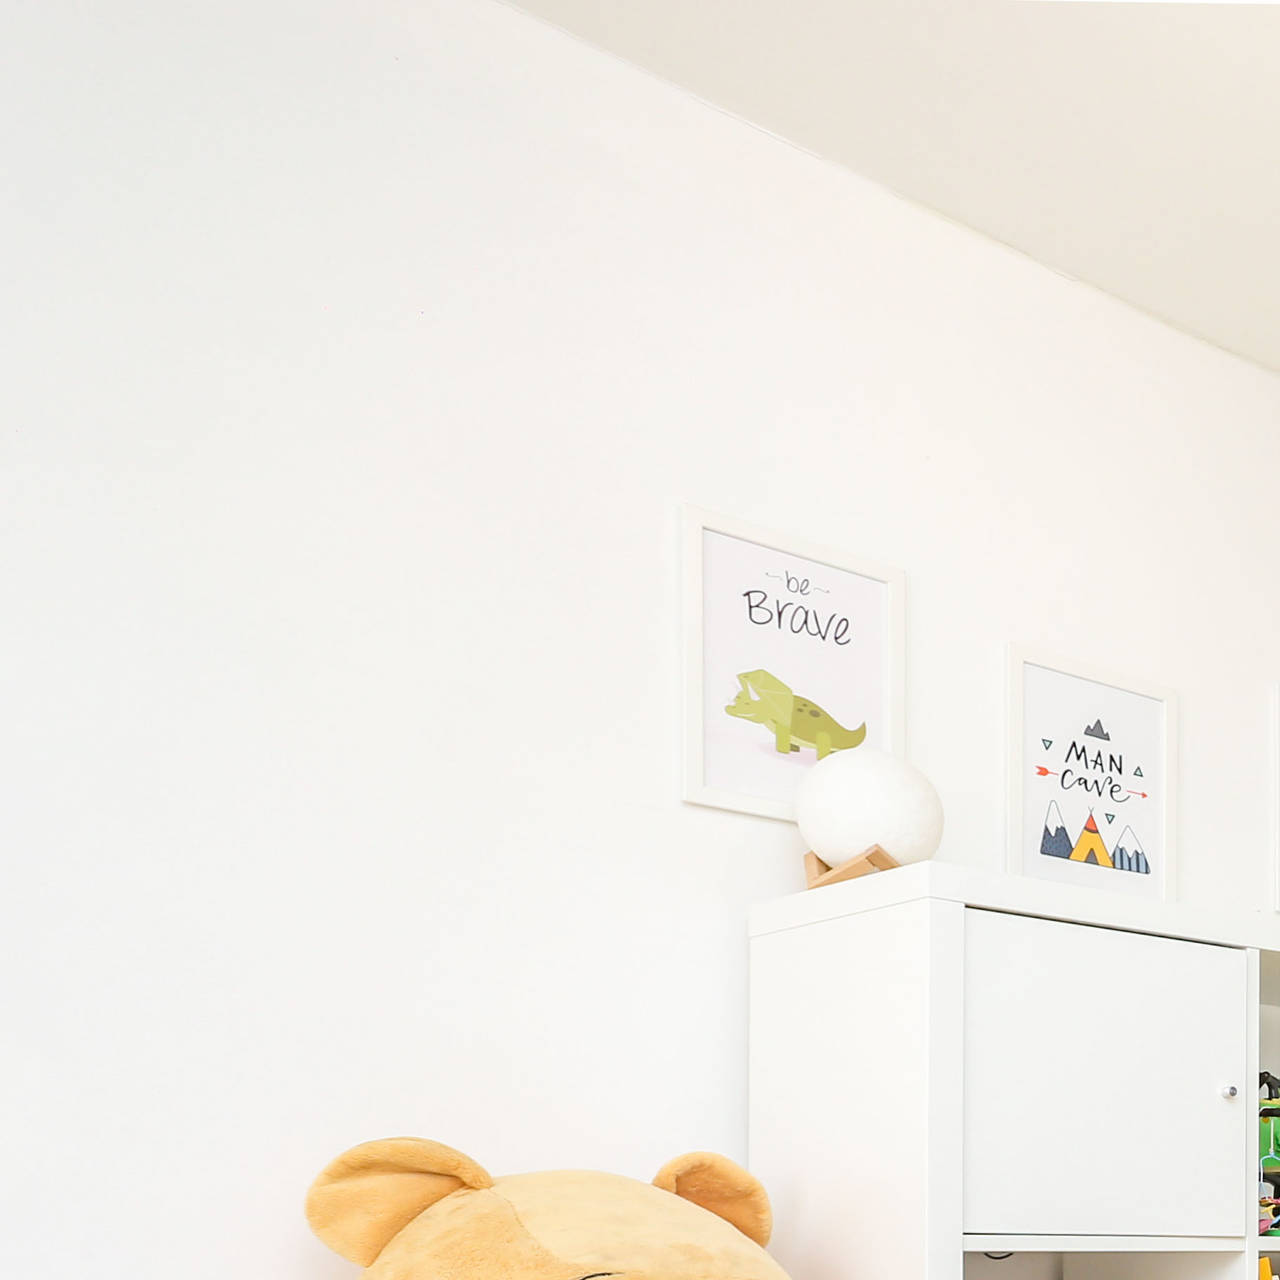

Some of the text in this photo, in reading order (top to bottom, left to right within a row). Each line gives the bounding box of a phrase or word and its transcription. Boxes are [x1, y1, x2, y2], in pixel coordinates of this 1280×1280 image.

[785, 570, 811, 597] be
[743, 589, 852, 647] Brave
[1065, 740, 1124, 776] MAN
[1060, 767, 1131, 803] cave
